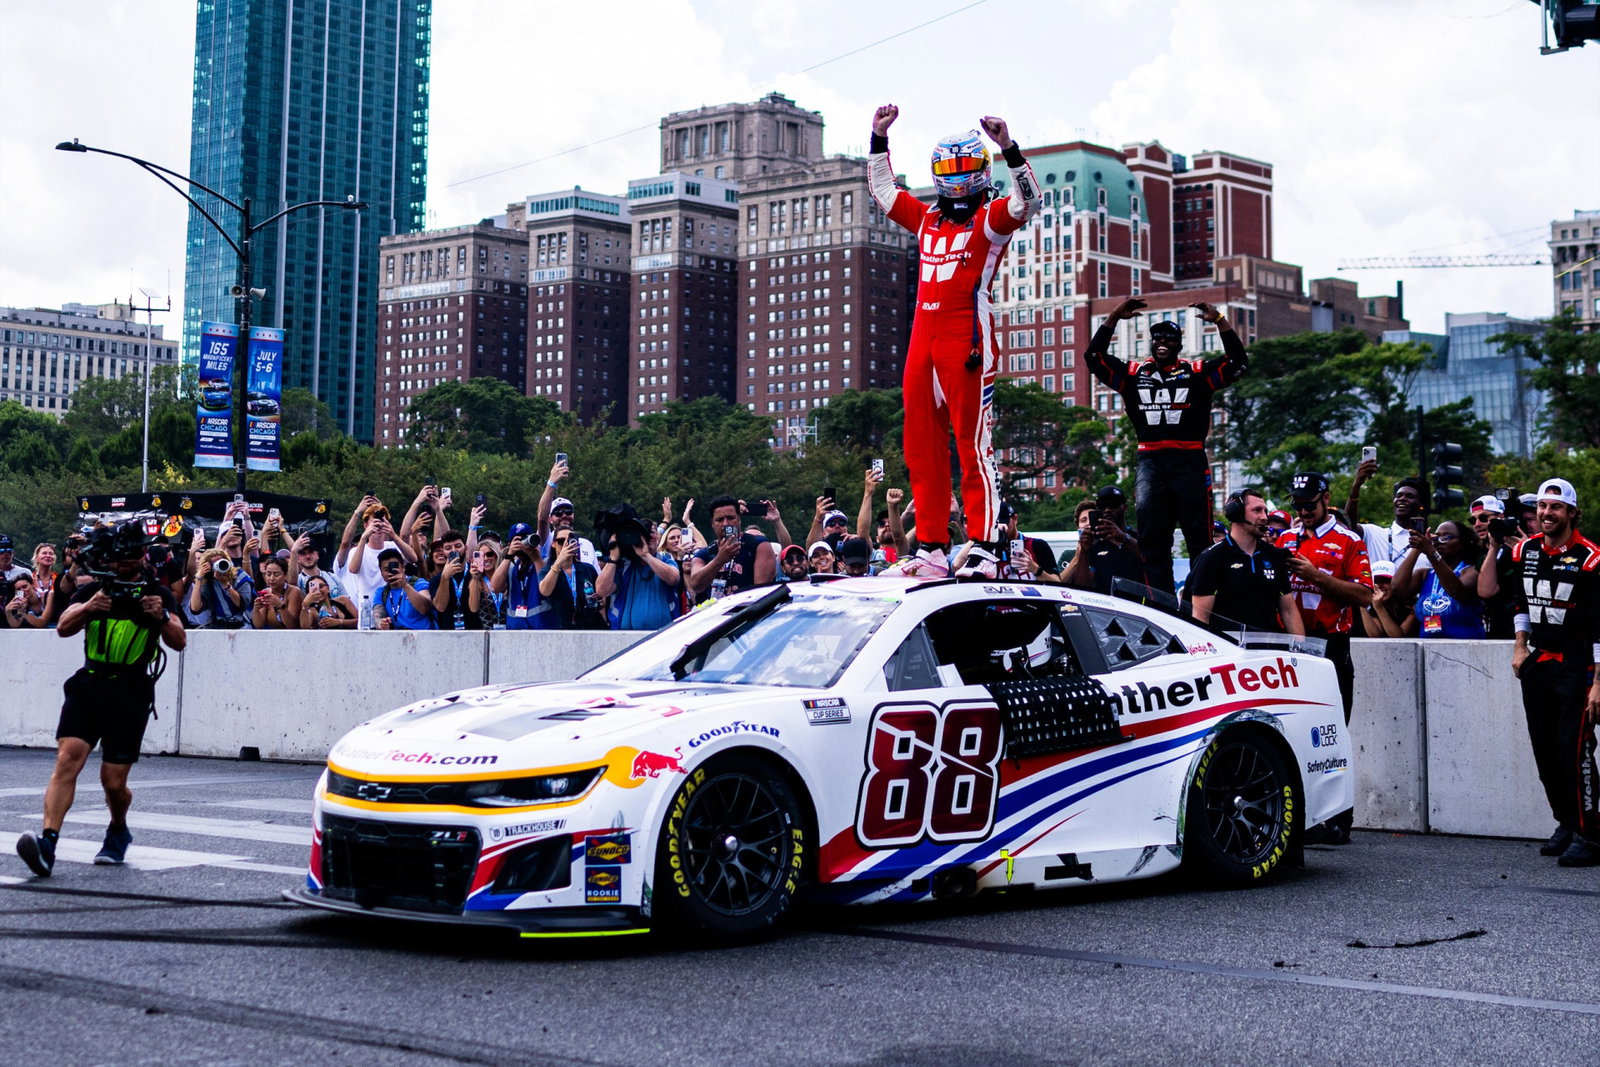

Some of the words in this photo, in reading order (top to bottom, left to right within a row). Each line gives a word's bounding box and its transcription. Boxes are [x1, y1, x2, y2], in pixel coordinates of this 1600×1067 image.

[209, 341, 230, 356] 165
[257, 351, 277, 361] JULY
[205, 361, 228, 371] MILES
[255, 362, 273, 373] 5-6
[200, 424, 228, 432] CHICAGO
[207, 418, 228, 426] NASCAR
[816, 699, 840, 708] NASCAR
[825, 709, 844, 718] SERIES
[688, 720, 780, 748] GOODYEAR
[1320, 724, 1337, 736] QUAD
[1321, 734, 1338, 747] LOCK
[1196, 740, 1219, 790] EAGLE
[1307, 757, 1347, 773] SafetyCulture
[854, 698, 1004, 850] 88
[506, 820, 558, 836] TRACKHOUSE
[668, 768, 705, 897] GOODYEAR
[1252, 785, 1293, 878] GOODYEAR
[430, 830, 468, 841] ZL1
[588, 844, 630, 857] SUNOCO
[588, 875, 618, 884] SUNOCO
[587, 889, 619, 897] ROOKIE
